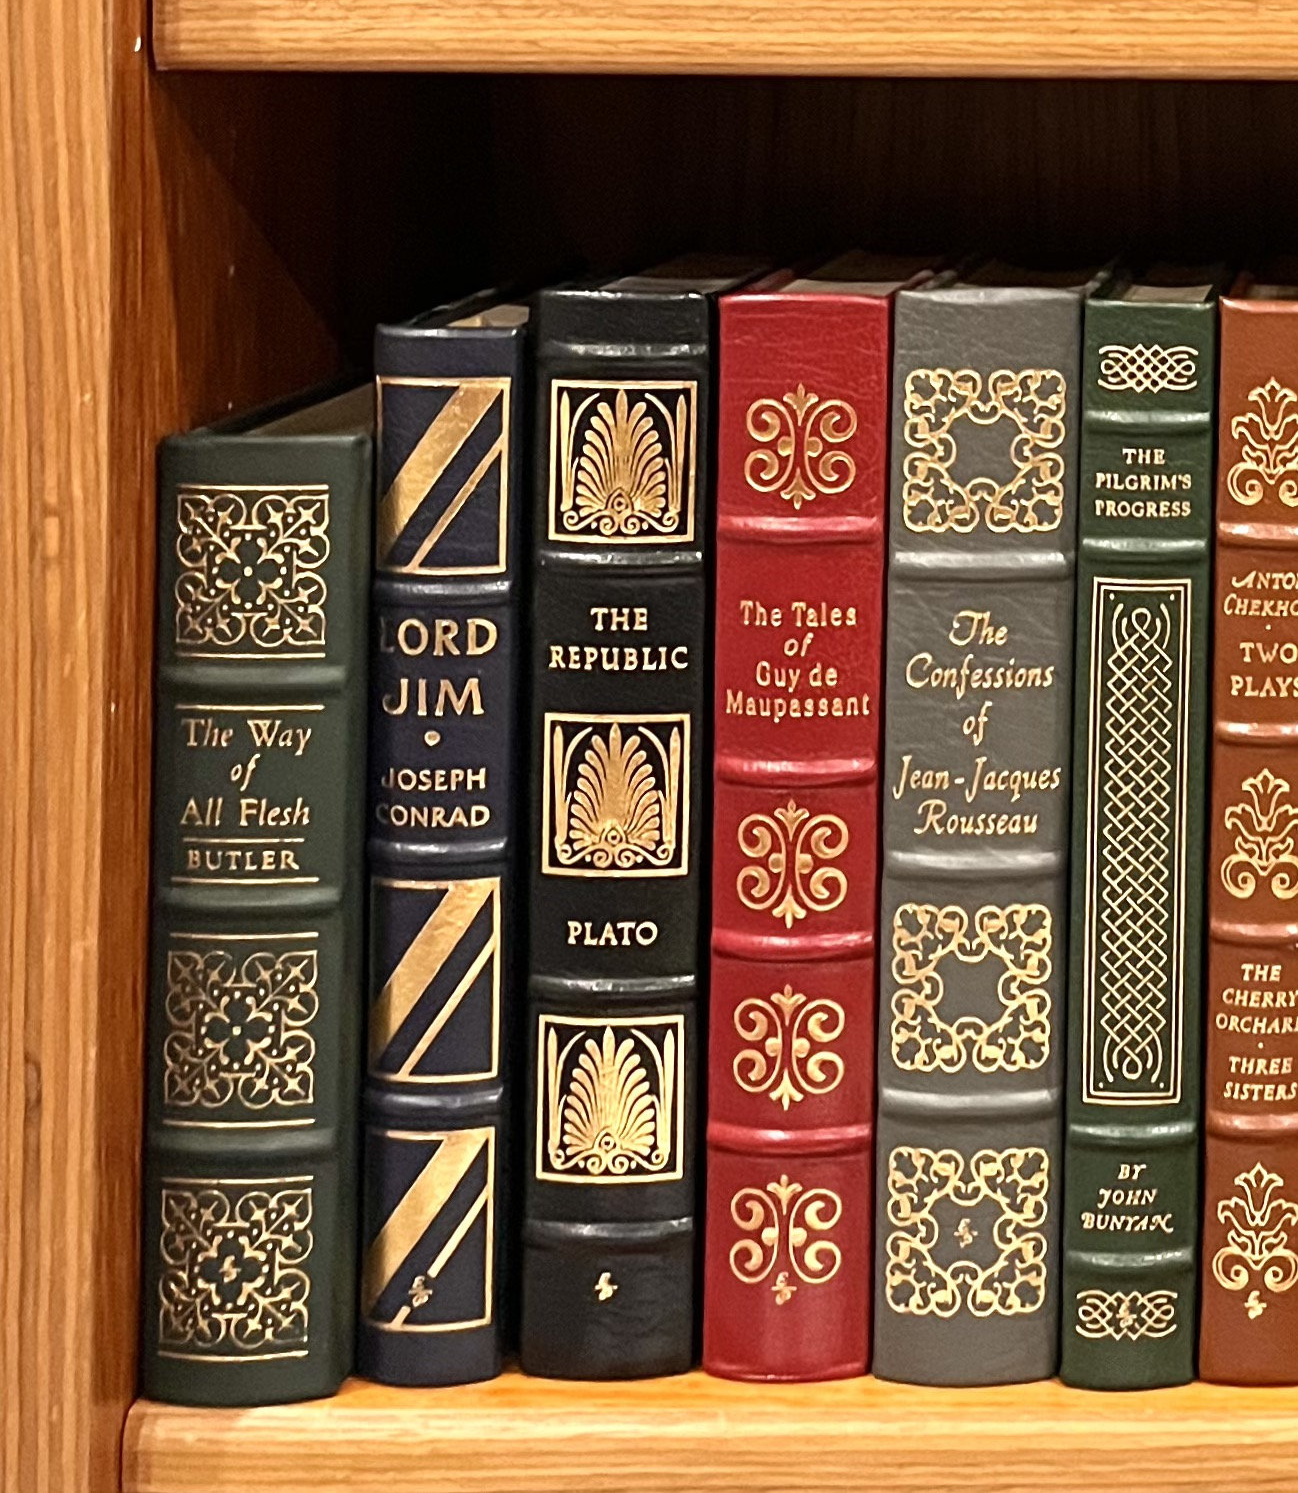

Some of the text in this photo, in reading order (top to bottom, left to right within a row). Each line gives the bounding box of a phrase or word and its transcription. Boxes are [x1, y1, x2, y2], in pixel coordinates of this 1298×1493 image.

[1121, 447, 1166, 466] THE
[1094, 471, 1193, 492] PILGRIM'S
[1094, 498, 1192, 519] PROGRESS
[589, 606, 649, 633] THE
[739, 600, 858, 629] The Tales
[948, 609, 1009, 647] The
[379, 615, 498, 657] LORD
[783, 632, 815, 658] of
[547, 645, 690, 672] REPUBLIC
[755, 661, 839, 693] Guy de
[905, 651, 1055, 701] Confessions
[381, 676, 486, 718] JIM
[724, 688, 872, 724] Maupassant
[180, 717, 313, 757] The Way
[962, 700, 994, 747] of
[229, 752, 262, 793] of
[380, 766, 488, 792] JOSEPH
[891, 754, 1063, 803] Jean-Jacques
[179, 796, 311, 828] All Flesh
[375, 802, 491, 829] CONRAD
[912, 798, 1039, 836] Rousseau
[186, 848, 301, 872] BUTLER
[566, 920, 659, 947] PLATO
[1240, 963, 1283, 983] THE
[1228, 1055, 1295, 1077] THREE
[1222, 1080, 1298, 1103] SISTERS
[1117, 1163, 1148, 1181] BY
[1096, 1187, 1158, 1210] JOHN
[1080, 1211, 1175, 1235] BUNYAN
